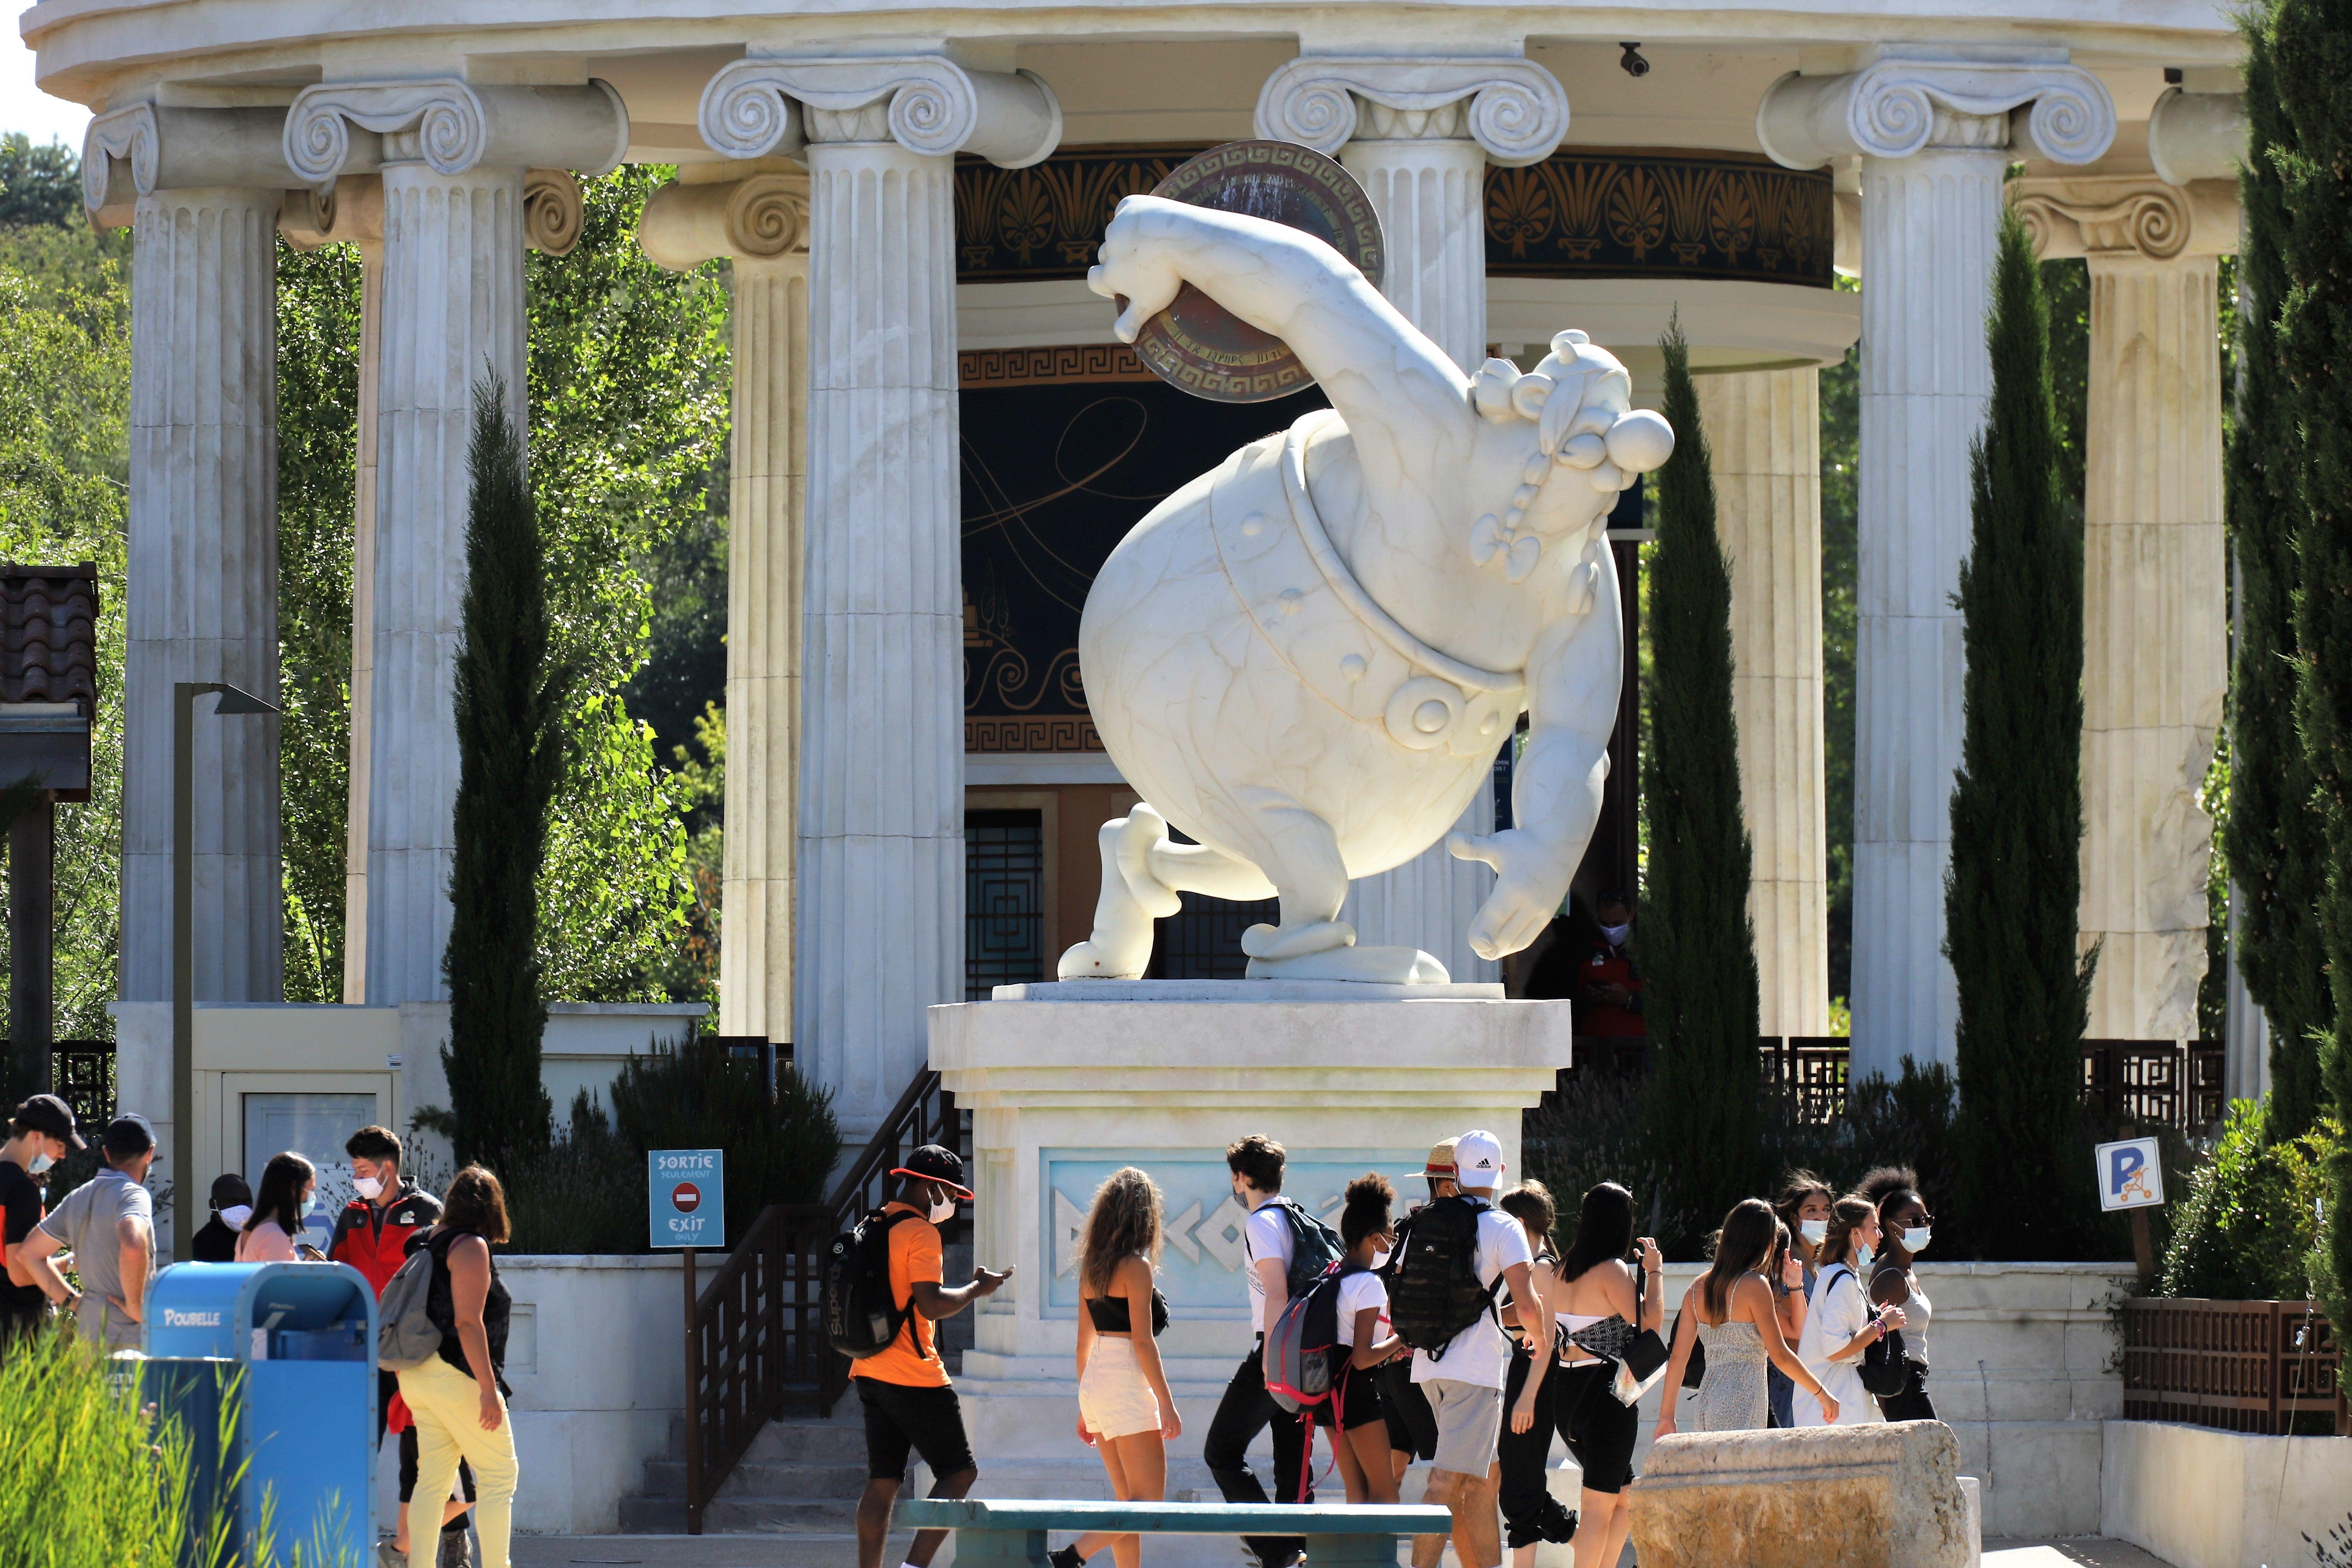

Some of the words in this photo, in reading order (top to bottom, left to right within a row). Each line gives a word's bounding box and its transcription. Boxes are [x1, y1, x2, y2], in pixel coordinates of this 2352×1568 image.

[661, 1170, 711, 1179] SEULEMENT
[2111, 1147, 2144, 1195] P
[675, 1233, 699, 1242] ONLY
[164, 1309, 220, 1326] POUBELLE
